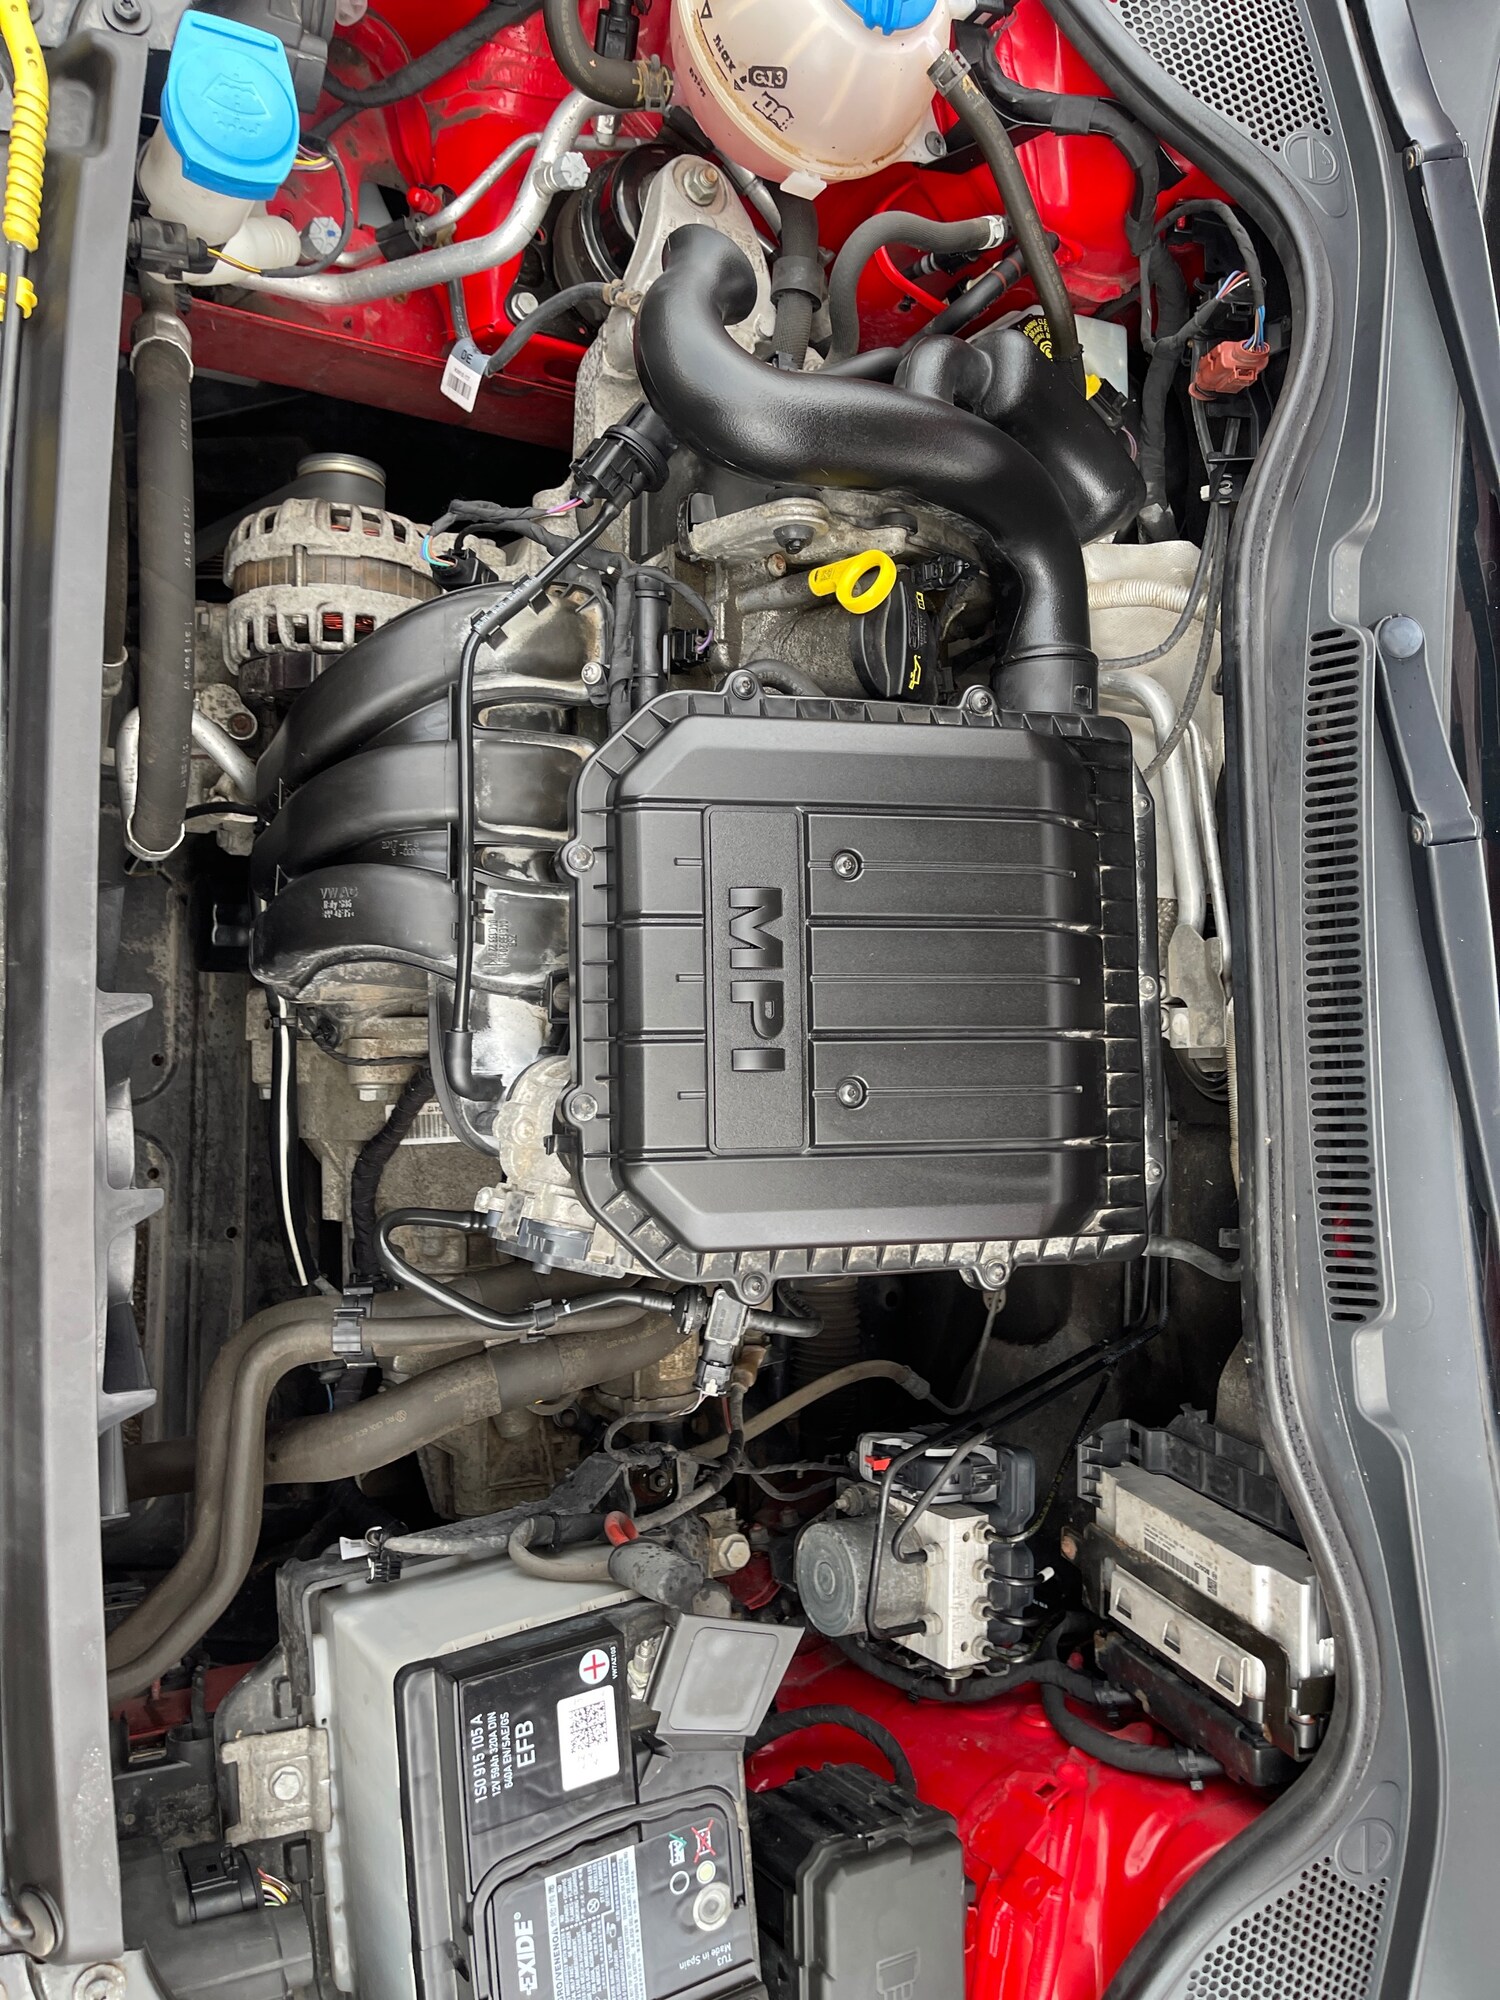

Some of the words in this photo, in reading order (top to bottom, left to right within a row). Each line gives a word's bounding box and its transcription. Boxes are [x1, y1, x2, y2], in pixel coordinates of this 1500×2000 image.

[752, 69, 784, 87] G13
[729, 887, 785, 1072] MPI
[470, 1713, 483, 1725] A
[487, 1711, 497, 1728] DIN
[471, 1727, 484, 1751] 105
[488, 1729, 498, 1753] 320A
[500, 1711, 512, 1763] EN/SAE/GS
[515, 1720, 536, 1768] EFB
[473, 1753, 486, 1778] 915
[490, 1754, 500, 1778] 59Ah
[503, 1764, 513, 1789] 640A
[475, 1780, 488, 1803] 1S0
[492, 1779, 501, 1797] 12V
[514, 1920, 538, 1996] EXIDE
[702, 1951, 710, 1960] in
[711, 1942, 731, 1956] Made
[717, 1953, 733, 1966] TU3
[679, 1954, 701, 1970] Spain
